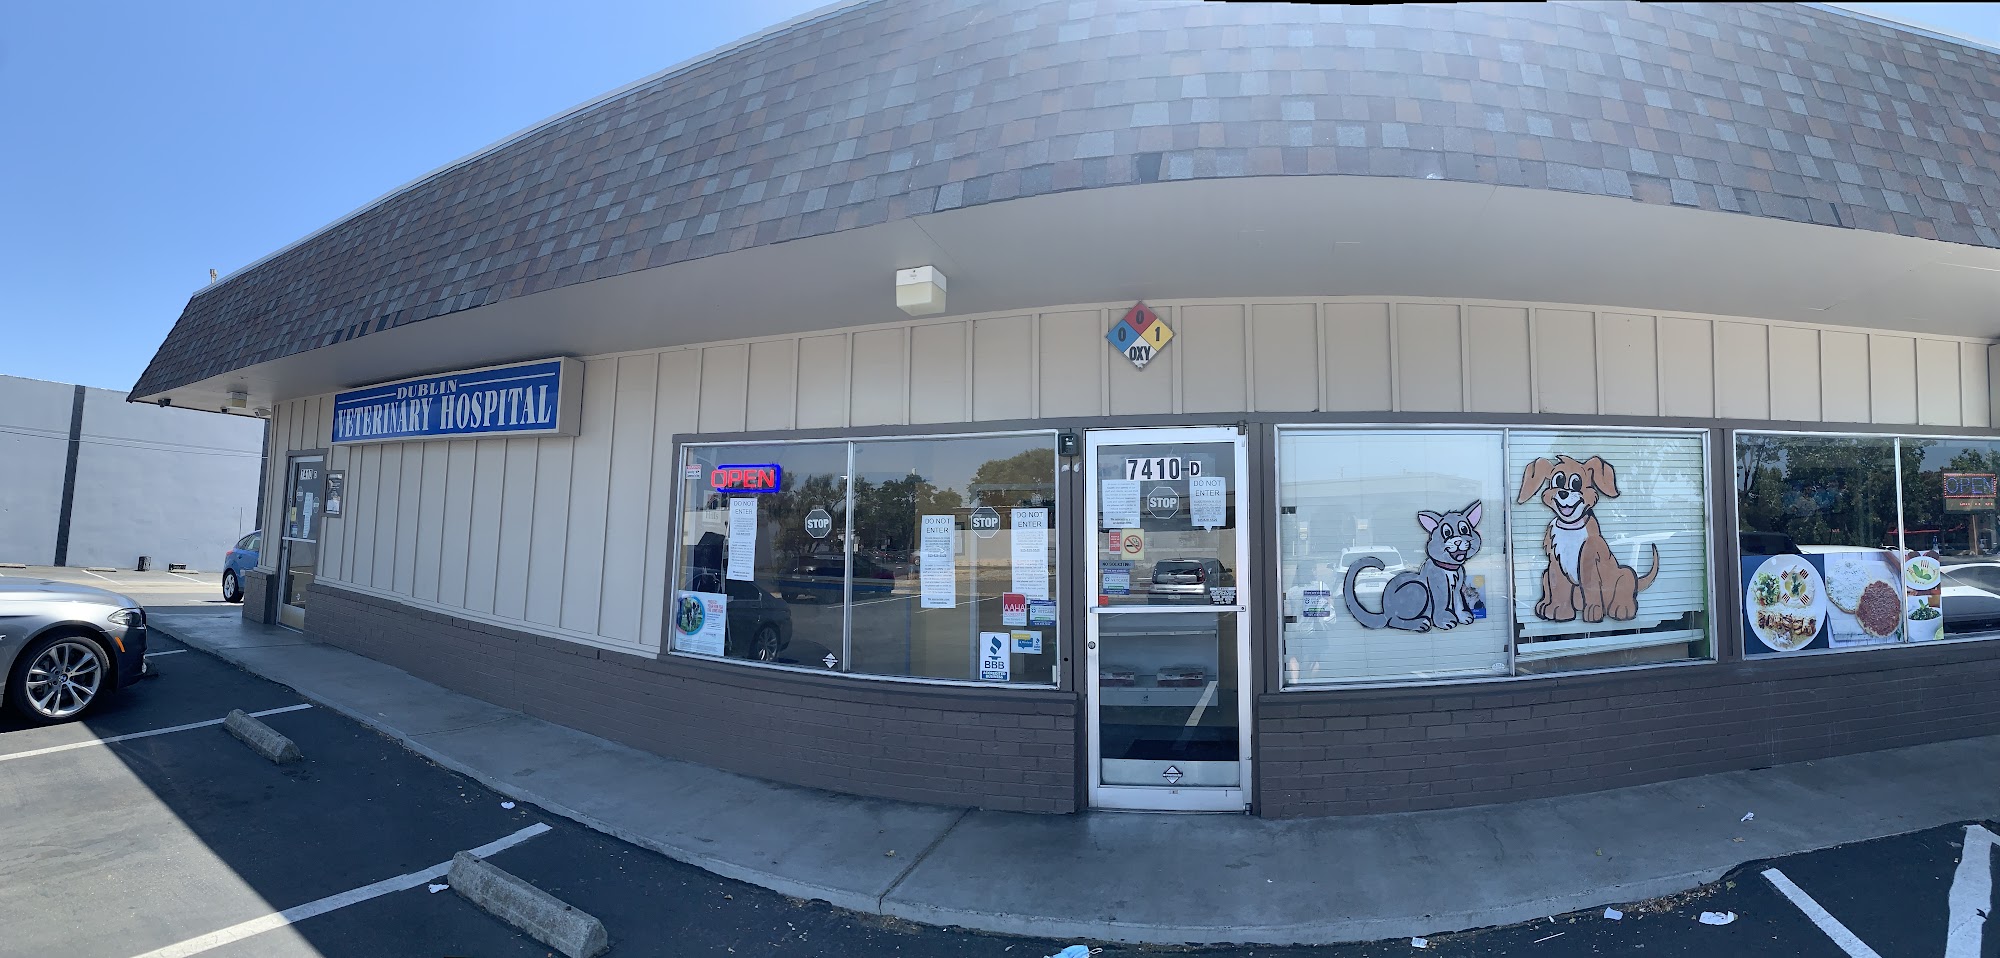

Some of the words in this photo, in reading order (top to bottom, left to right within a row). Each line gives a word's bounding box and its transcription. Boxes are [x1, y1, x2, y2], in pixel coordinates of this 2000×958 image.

[1136, 310, 1144, 325] 0
[1118, 327, 1126, 342] 0
[1155, 327, 1160, 341] 1
[1129, 346, 1151, 361] OXY
[397, 379, 458, 399] DUBLIN
[338, 398, 432, 438] VETERINARY
[440, 384, 552, 430] HOSPITAL
[711, 469, 775, 488] OPEN
[1946, 477, 1994, 493] OPEN
[1195, 489, 1220, 497] ENTER
[1149, 497, 1177, 509] STOP
[807, 519, 829, 529] STOP
[925, 517, 935, 525] DO
[936, 517, 950, 525] NOT
[973, 517, 998, 528] STOP
[1004, 603, 1025, 612] AAHA
[984, 660, 1005, 670] BBB
